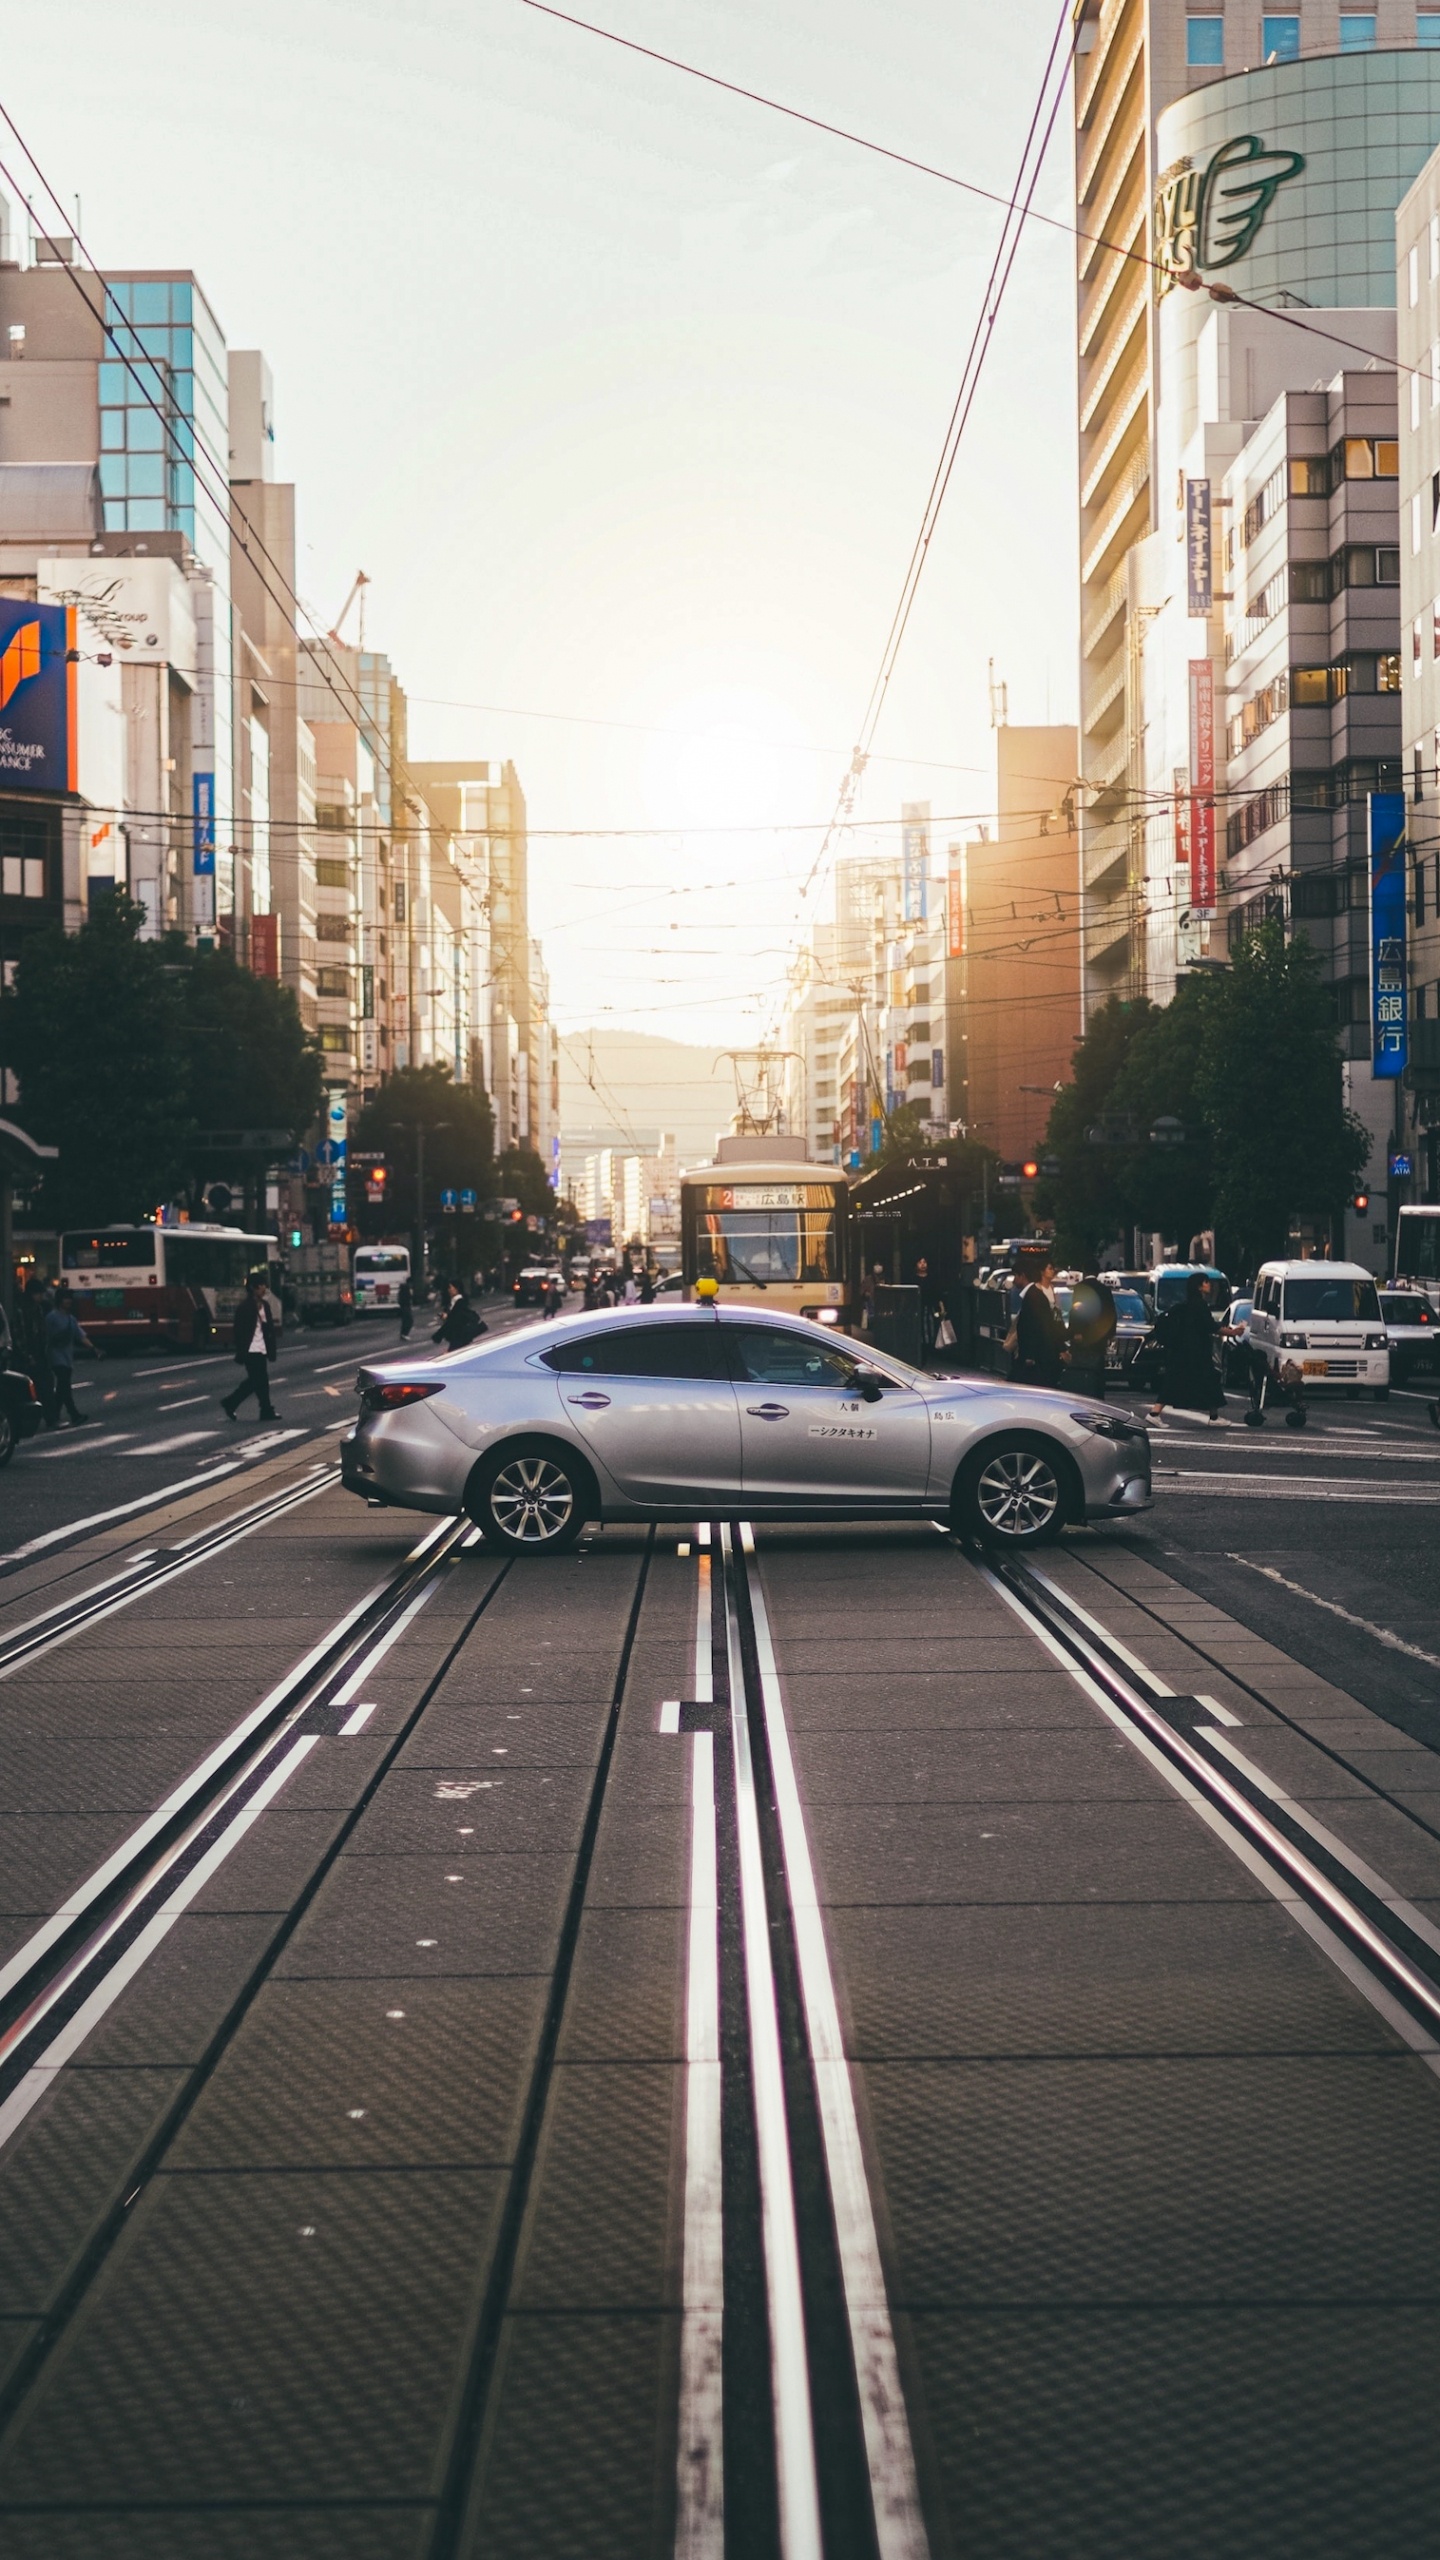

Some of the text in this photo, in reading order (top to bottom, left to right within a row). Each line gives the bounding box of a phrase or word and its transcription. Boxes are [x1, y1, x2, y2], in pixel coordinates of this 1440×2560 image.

[1190, 480, 1209, 593] アートネイチャー
[1196, 911, 1210, 920] 3F
[1377, 936, 1404, 1052] 広島銀行
[907, 1157, 948, 1167] 八丁堀
[1394, 1166, 1411, 1175] ATM
[723, 1190, 732, 1206] 2
[761, 1193, 805, 1206] 広島駅
